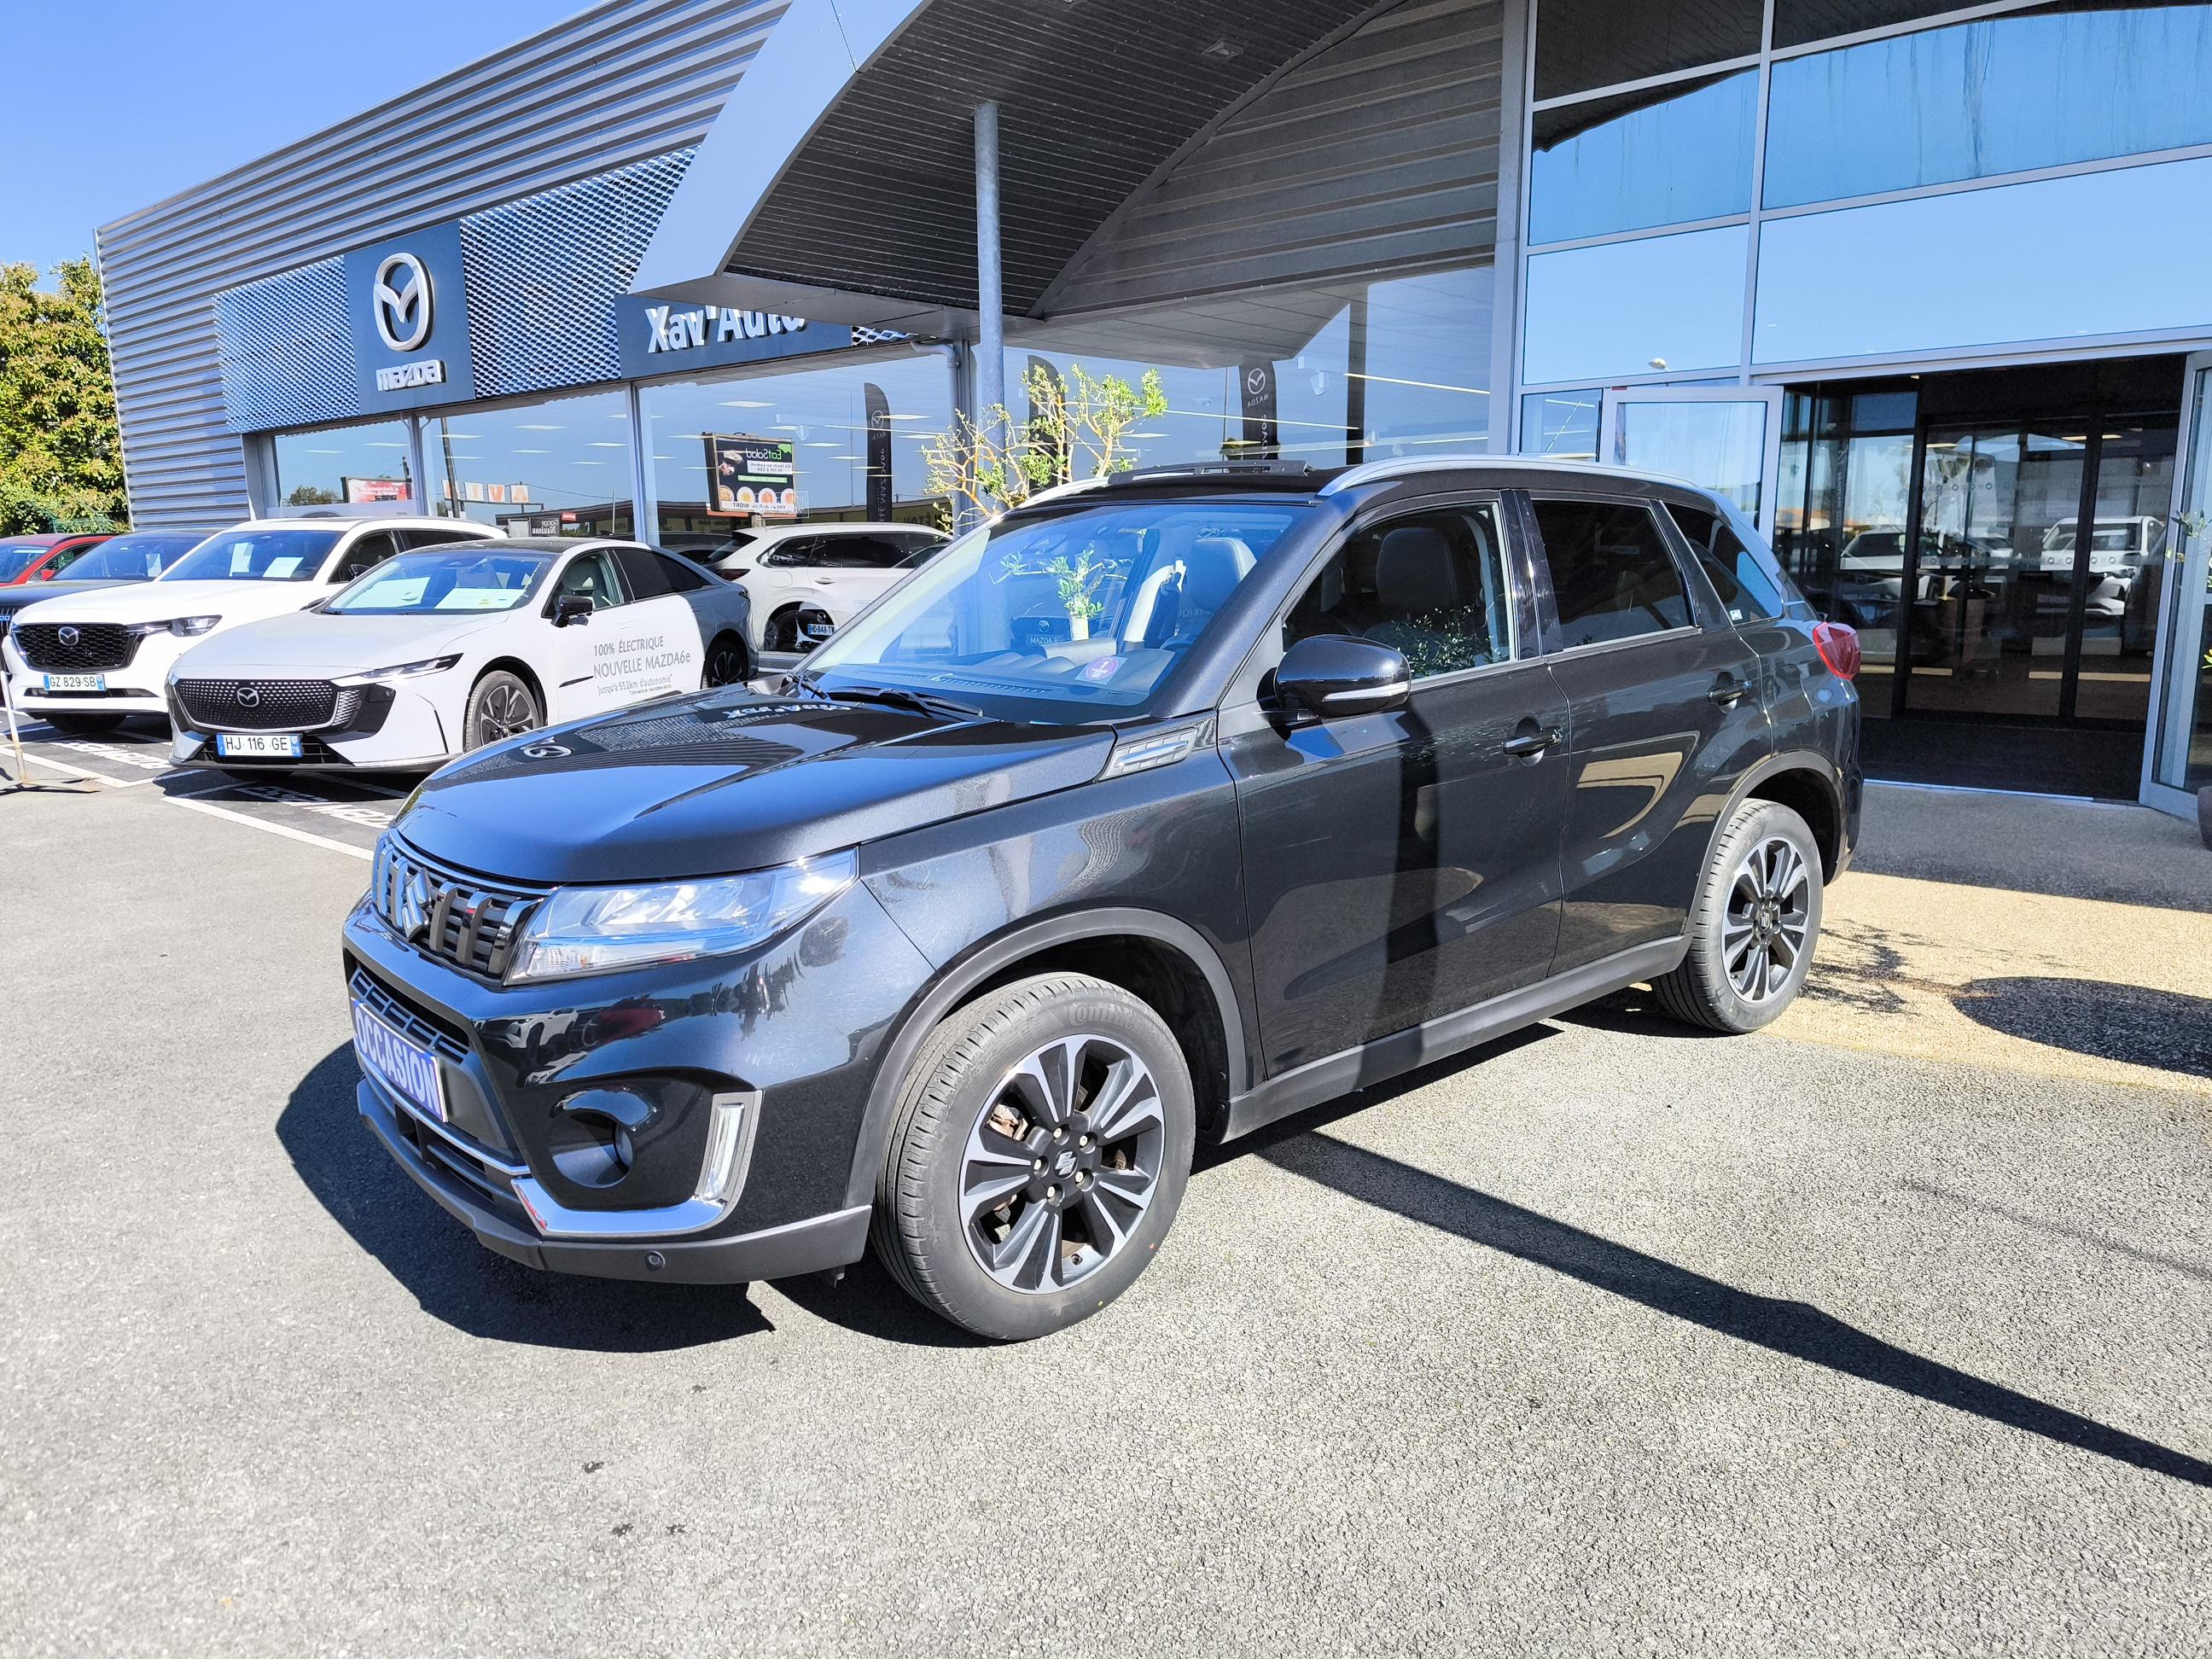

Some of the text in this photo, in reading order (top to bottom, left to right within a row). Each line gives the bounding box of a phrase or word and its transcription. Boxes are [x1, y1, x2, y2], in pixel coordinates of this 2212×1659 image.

[593, 636, 664, 657] 100% ÉLECTRIQUE
[593, 651, 691, 679] NOUVELLE MAZDA6e
[355, 1006, 441, 1115] OCCASION
